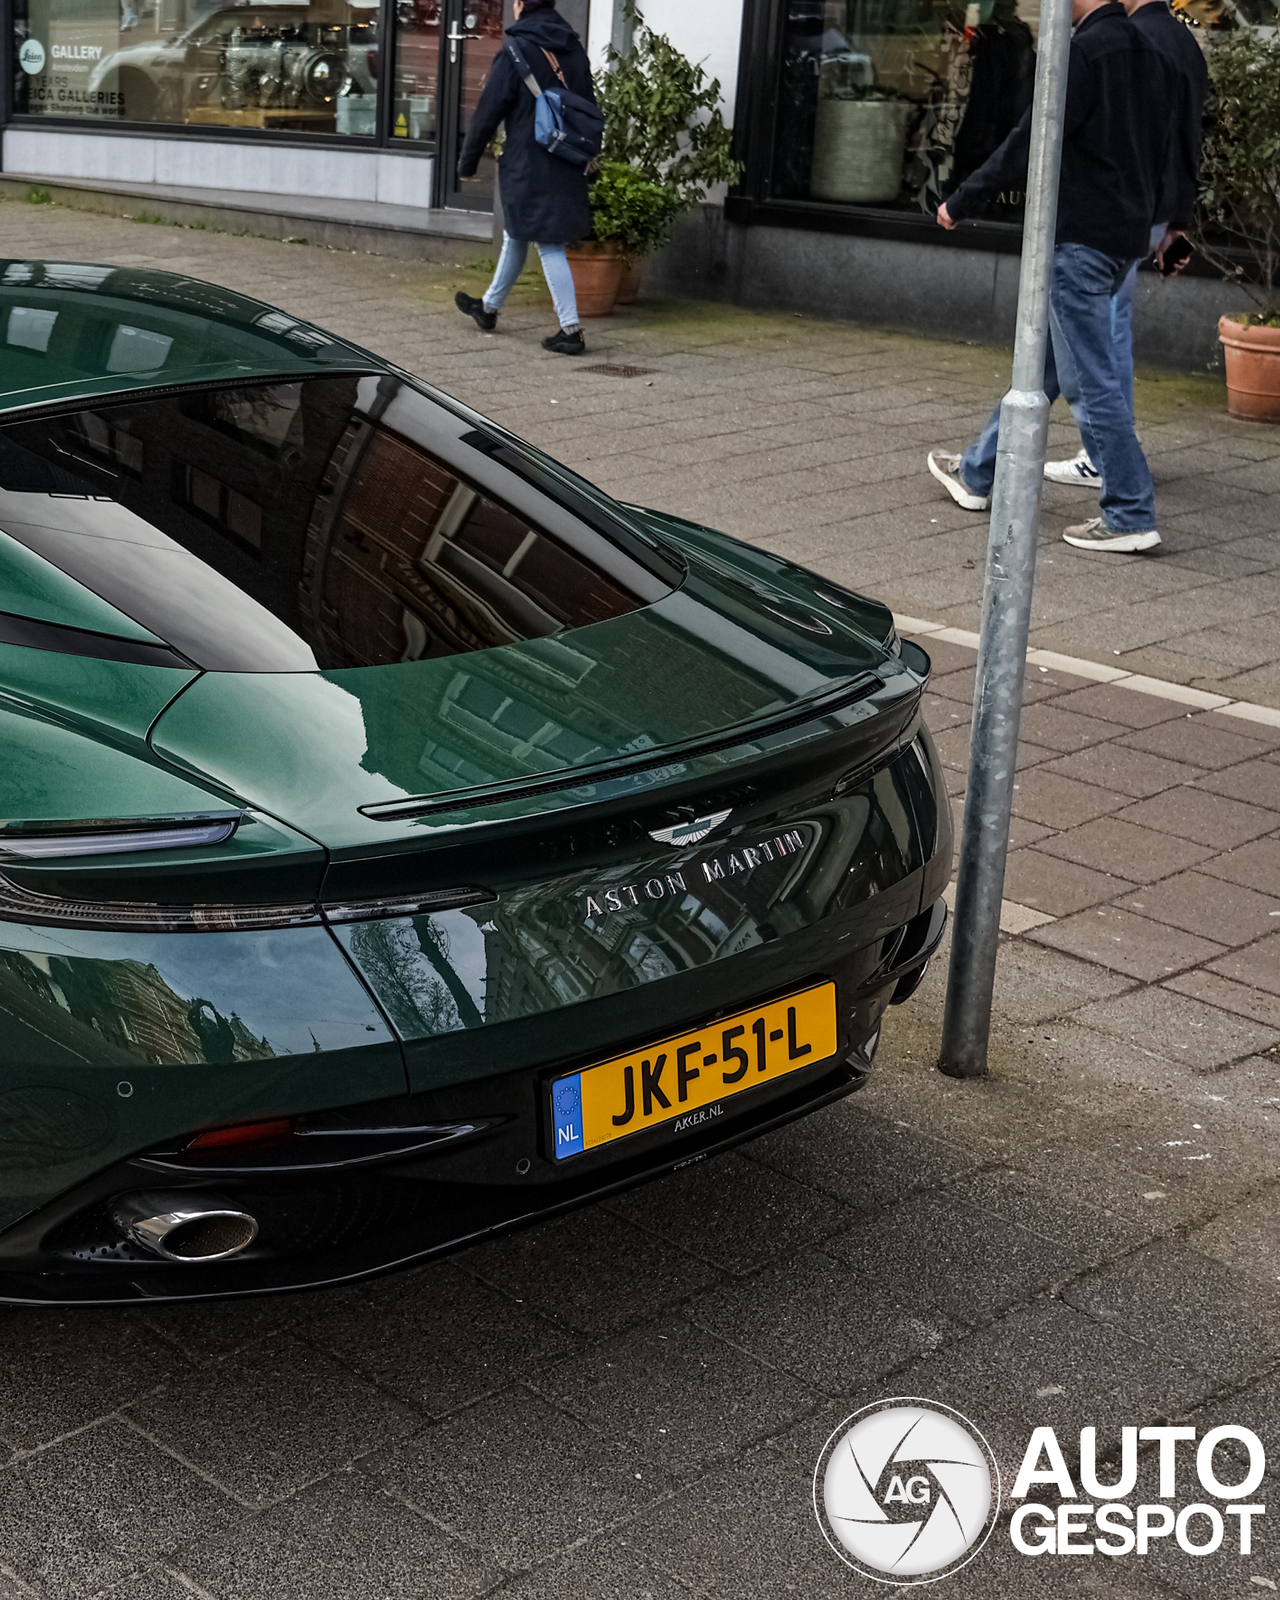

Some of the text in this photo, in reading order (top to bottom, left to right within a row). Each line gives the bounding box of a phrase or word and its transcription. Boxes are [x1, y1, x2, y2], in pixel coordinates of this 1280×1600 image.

[22, 48, 42, 63] Leica
[51, 44, 103, 60] GALLERY
[52, 63, 89, 73] Amsterdam
[57, 89, 126, 105] GALLERIES
[585, 830, 805, 919] ASTON MARTIN
[611, 1006, 812, 1127] JKF-51-L
[557, 1123, 579, 1146] NL
